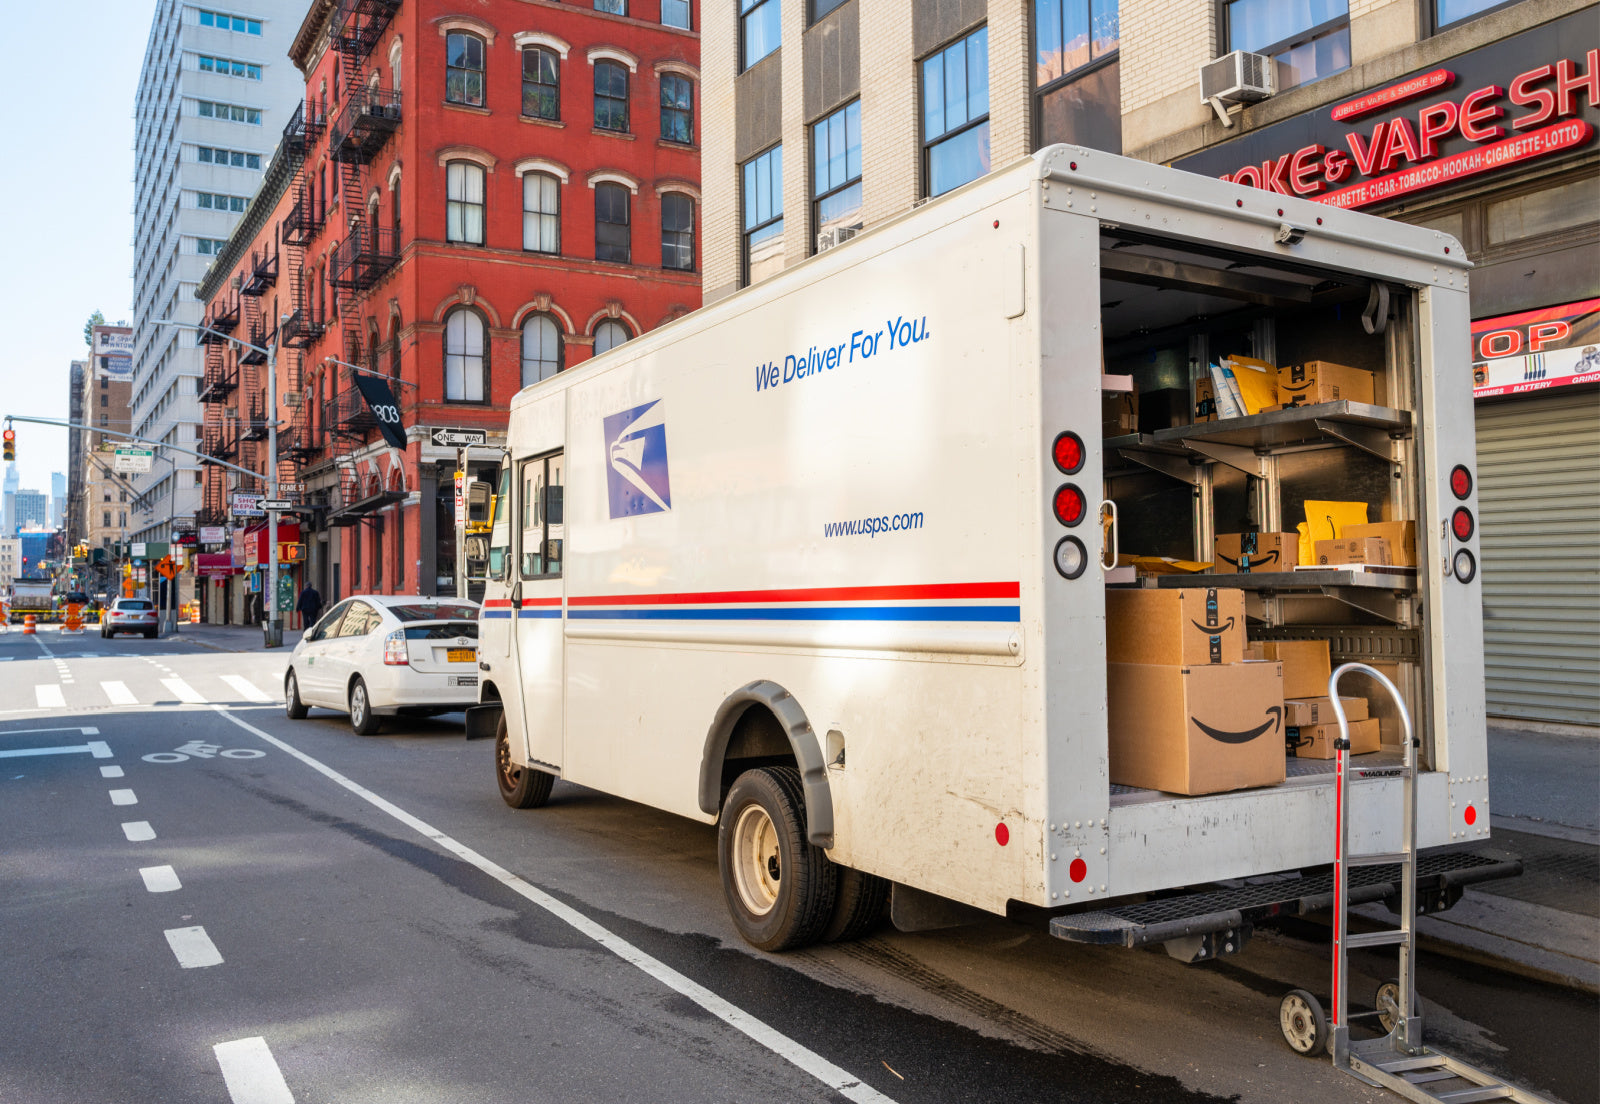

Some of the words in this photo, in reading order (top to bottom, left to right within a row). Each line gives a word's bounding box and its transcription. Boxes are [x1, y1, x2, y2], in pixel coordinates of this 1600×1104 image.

[1334, 101, 1366, 118] JUBILEE
[1367, 93, 1388, 106] VAPE
[1390, 89, 1396, 98] &
[1398, 79, 1428, 95] SMOKE
[1219, 144, 1324, 197] OKE
[1345, 86, 1502, 176] VAPE
[1370, 178, 1396, 199] CIGAR
[1399, 165, 1438, 191] TOBACCO
[1443, 151, 1481, 178] HOOKAH
[1485, 135, 1540, 165] CIGARETTE
[1545, 124, 1579, 148] LOTTO
[756, 361, 780, 392] We
[783, 343, 846, 384] Deliver
[849, 330, 883, 363] For
[887, 316, 930, 350] You.
[1471, 321, 1572, 360] OP
[1474, 388, 1504, 398] UMMIES
[1512, 381, 1552, 393] BATTERY
[437, 433, 455, 442] ONE
[464, 434, 482, 443] WAY
[824, 511, 924, 538] www.usps.com
